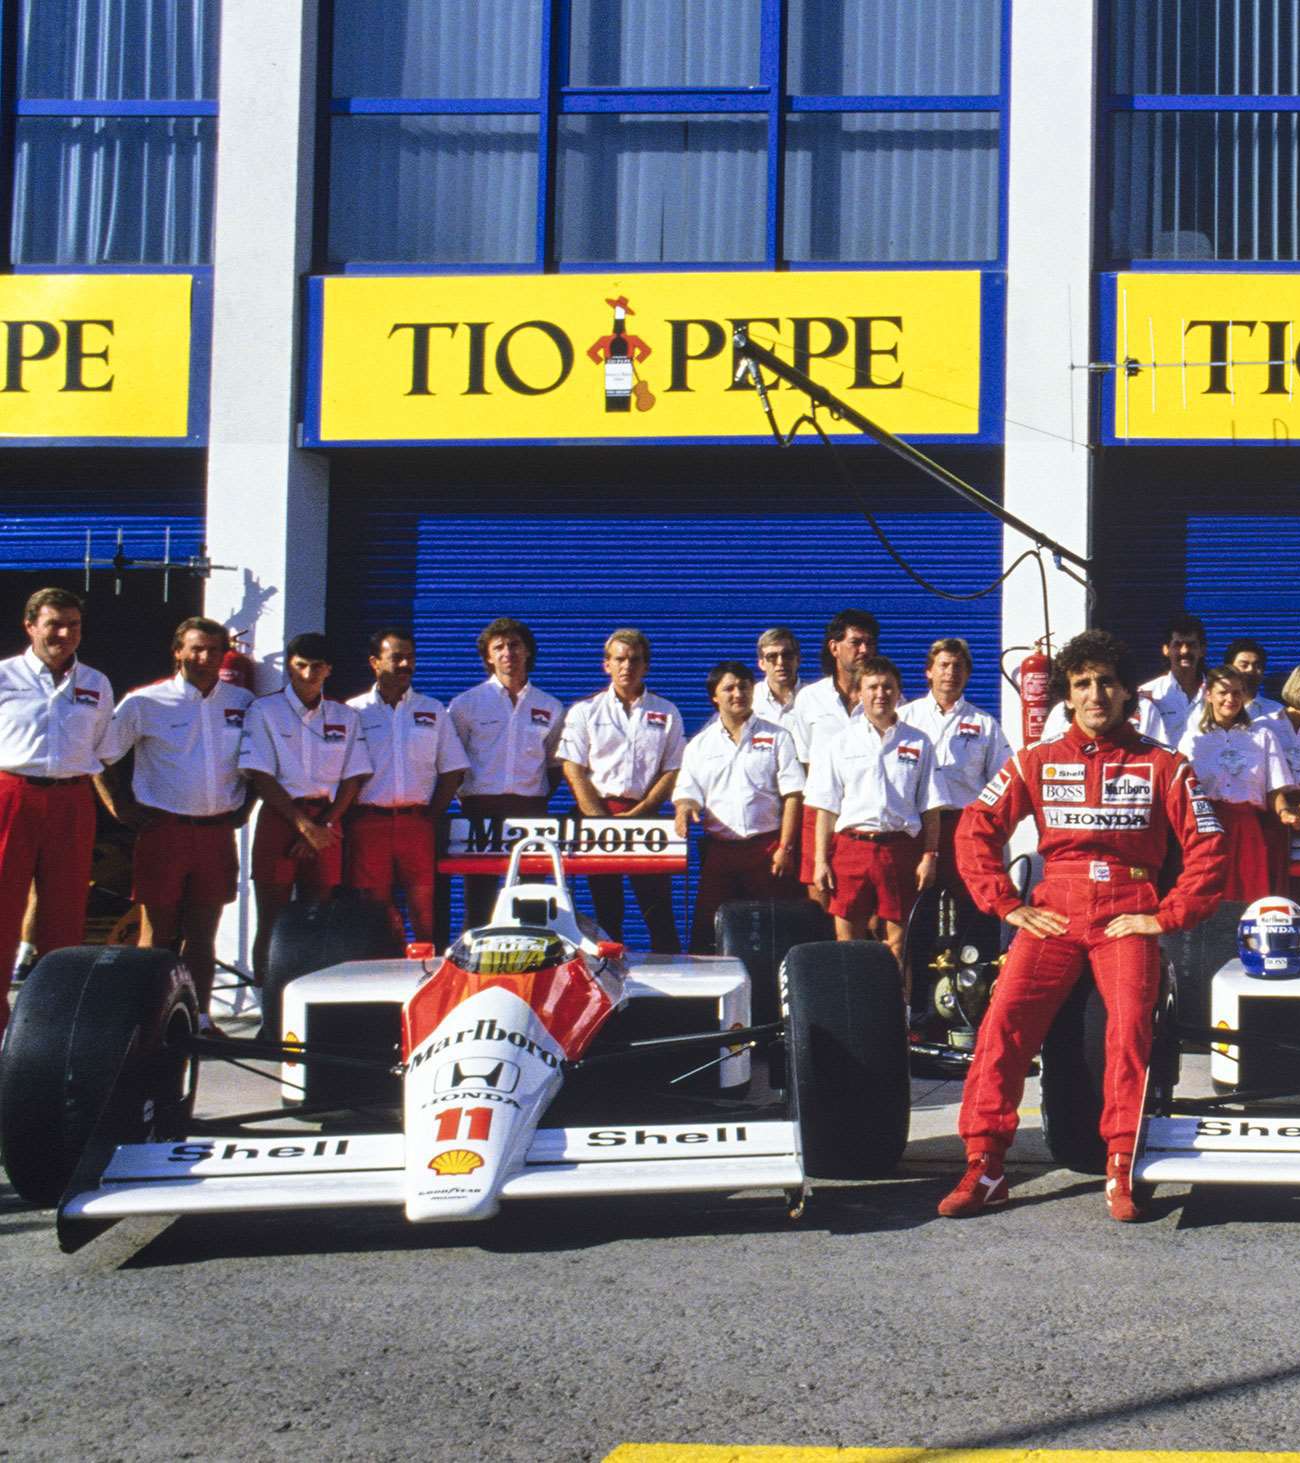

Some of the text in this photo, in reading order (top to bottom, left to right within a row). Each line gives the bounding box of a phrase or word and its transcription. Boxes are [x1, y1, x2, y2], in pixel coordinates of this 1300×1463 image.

[0, 320, 115, 393] PE
[389, 316, 905, 396] TIO PEPE
[1058, 770, 1085, 778] Shell
[1046, 785, 1083, 798] BOSS
[1104, 779, 1150, 795] Marlboro
[1064, 813, 1149, 826] HONDA
[465, 815, 669, 854] Marlboro
[410, 1019, 558, 1073] Marlboro
[422, 1092, 523, 1110] HONDA
[434, 1107, 494, 1142] 11
[587, 1127, 748, 1147] Shell
[168, 1140, 348, 1163] Shell
